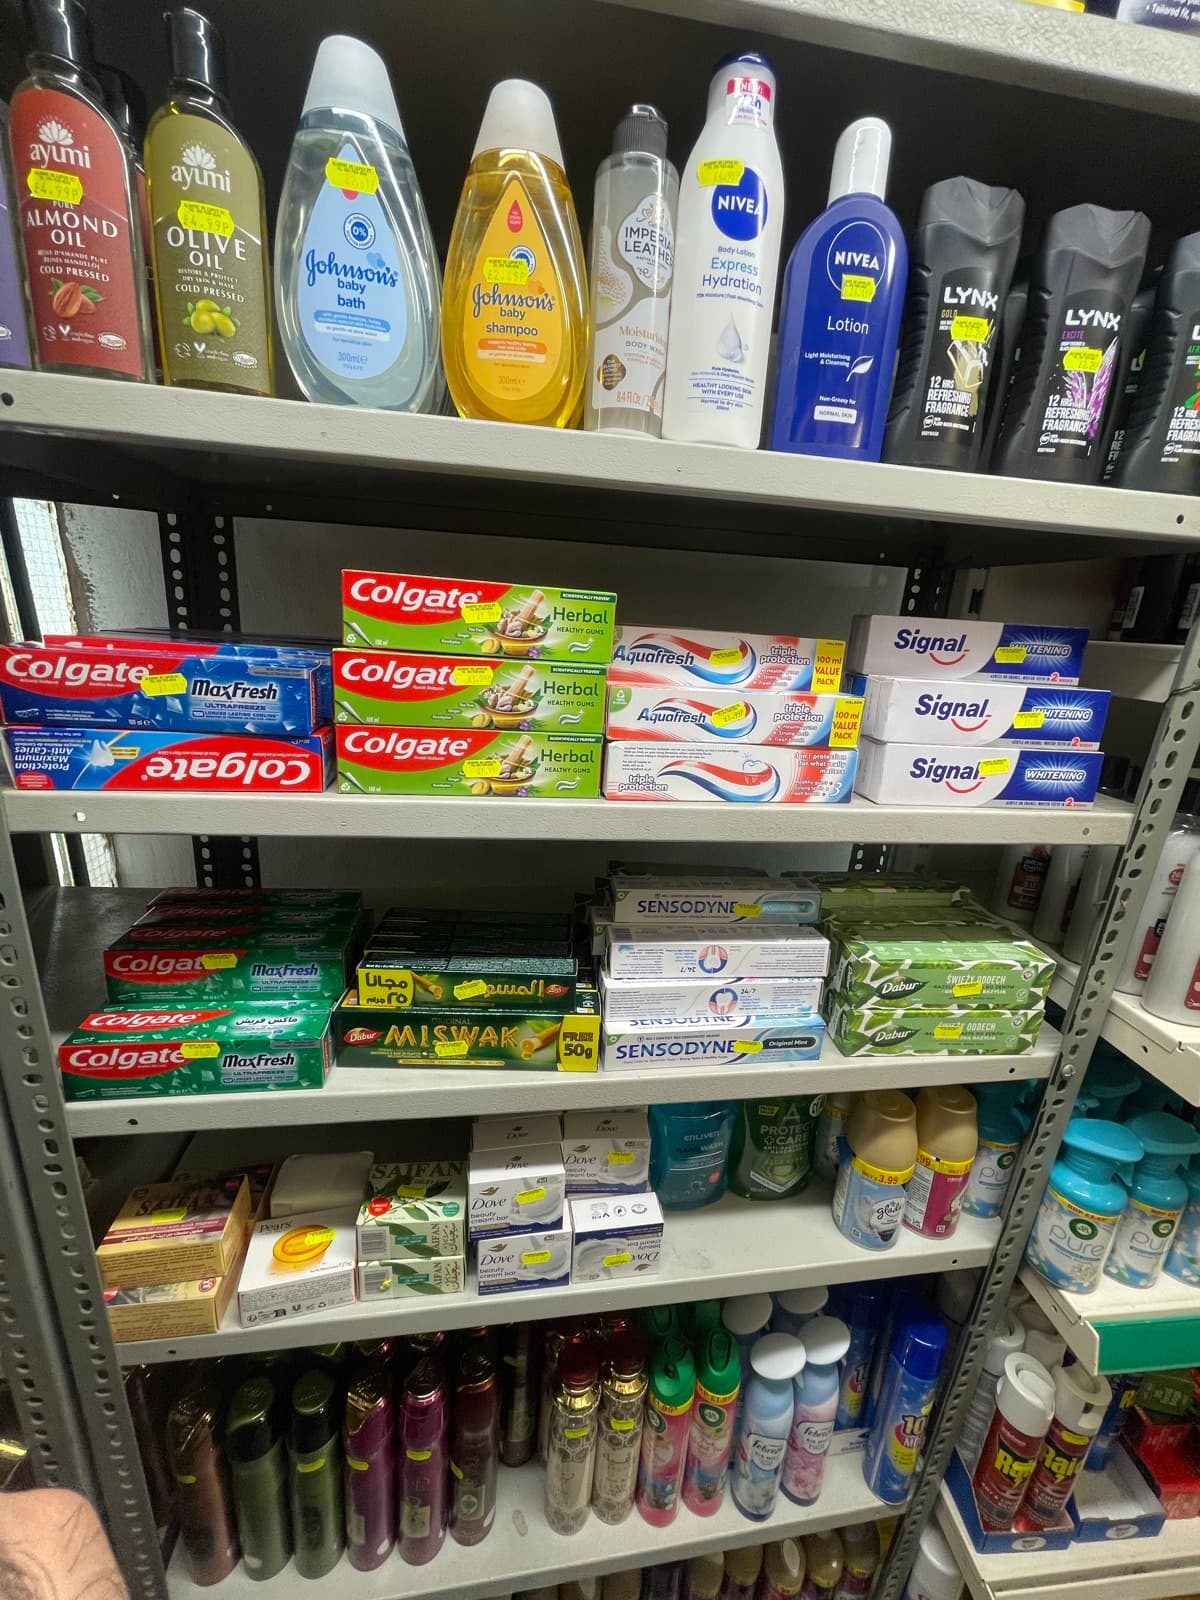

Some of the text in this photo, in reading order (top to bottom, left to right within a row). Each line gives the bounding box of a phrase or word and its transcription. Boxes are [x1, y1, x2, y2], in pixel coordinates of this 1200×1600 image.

[30, 143, 91, 169] ayumi
[171, 163, 231, 193] ayumi
[717, 194, 764, 218] NIVEA
[27, 209, 118, 239] ALMOND
[51, 228, 86, 248] OIL
[167, 226, 246, 260] OLIVE
[625, 226, 672, 251] IMPERIA
[189, 250, 223, 270] OIL
[711, 257, 758, 276] Express
[834, 251, 879, 271] NIVEA
[40, 265, 110, 282] COLD PRESSED
[305, 248, 396, 288] Johnson's
[337, 277, 366, 295] baby
[702, 274, 763, 296] Hydration
[176, 283, 244, 303] COLD PRESSED
[472, 283, 555, 318] Johnson's
[943, 286, 999, 311] LYNX
[337, 294, 366, 310] bath
[500, 306, 526, 320] baby
[1065, 309, 1121, 331] LYNX
[486, 322, 538, 336] shampoo
[827, 316, 869, 335] Lotion
[625, 341, 647, 350] BODY
[930, 376, 941, 388] 12
[927, 388, 972, 405] REFRESHING
[1049, 395, 1060, 406] 12
[925, 401, 970, 418] FRAGRANCE
[1045, 407, 1090, 421] REFRESHING
[1173, 406, 1184, 417] 12
[1042, 419, 1088, 435] FRAGRANCE
[350, 578, 480, 611] Colgate
[553, 607, 609, 625] Herbal
[556, 626, 583, 634] HEALTHY
[894, 629, 967, 653] Signal
[1010, 641, 1071, 656] WHITENING
[613, 645, 695, 666] Aquafresh
[771, 646, 797, 656] triple
[760, 655, 810, 665] protection
[817, 656, 842, 665] 100 ml
[4, 654, 150, 686] Colgate
[815, 666, 840, 675] VALUE
[1050, 673, 1059, 682] 2
[191, 679, 279, 700] MaxFresh
[543, 680, 599, 697] Herbal
[785, 704, 810, 713] triple
[915, 694, 989, 721] Signal
[637, 707, 706, 725] Aquafresh
[774, 713, 823, 722] protection
[833, 721, 858, 730] VALUE
[834, 732, 852, 740] PACK
[1072, 737, 1080, 746] 2
[14, 746, 74, 755] Anti-Caries
[344, 731, 469, 760] Colgate
[14, 755, 68, 763] Maximum
[541, 750, 595, 763] Herbal
[14, 763, 70, 771] Protection
[146, 753, 311, 785] Colgate
[910, 758, 980, 782] Signal
[628, 774, 654, 784] triple
[1026, 770, 1084, 781] WHITENING
[618, 783, 668, 793] protection
[1066, 798, 1074, 807] 2
[637, 899, 738, 914] SENSODYNE
[112, 954, 203, 975] Colgat
[252, 963, 318, 977] MaxFresh
[882, 982, 918, 994] Dabur
[89, 1013, 198, 1028] Colgate
[967, 1022, 996, 1031] ODDECH
[349, 1030, 378, 1043] Dabur
[384, 1024, 521, 1050] MISWAK
[562, 1032, 594, 1042] FREE
[875, 1031, 911, 1042] Dabur
[562, 1043, 594, 1059] 50g
[615, 1040, 735, 1060] SENSODYNE
[68, 1049, 185, 1070] Colgate
[222, 1053, 295, 1068] MaxFresh
[505, 1161, 529, 1170] Dove
[565, 1154, 597, 1165] Dove
[472, 1198, 507, 1210] Dove
[471, 1211, 497, 1219] beauty
[471, 1217, 496, 1225] cream
[1051, 1224, 1105, 1257] pure
[480, 1254, 515, 1266] Dove
[480, 1267, 505, 1275] beauty
